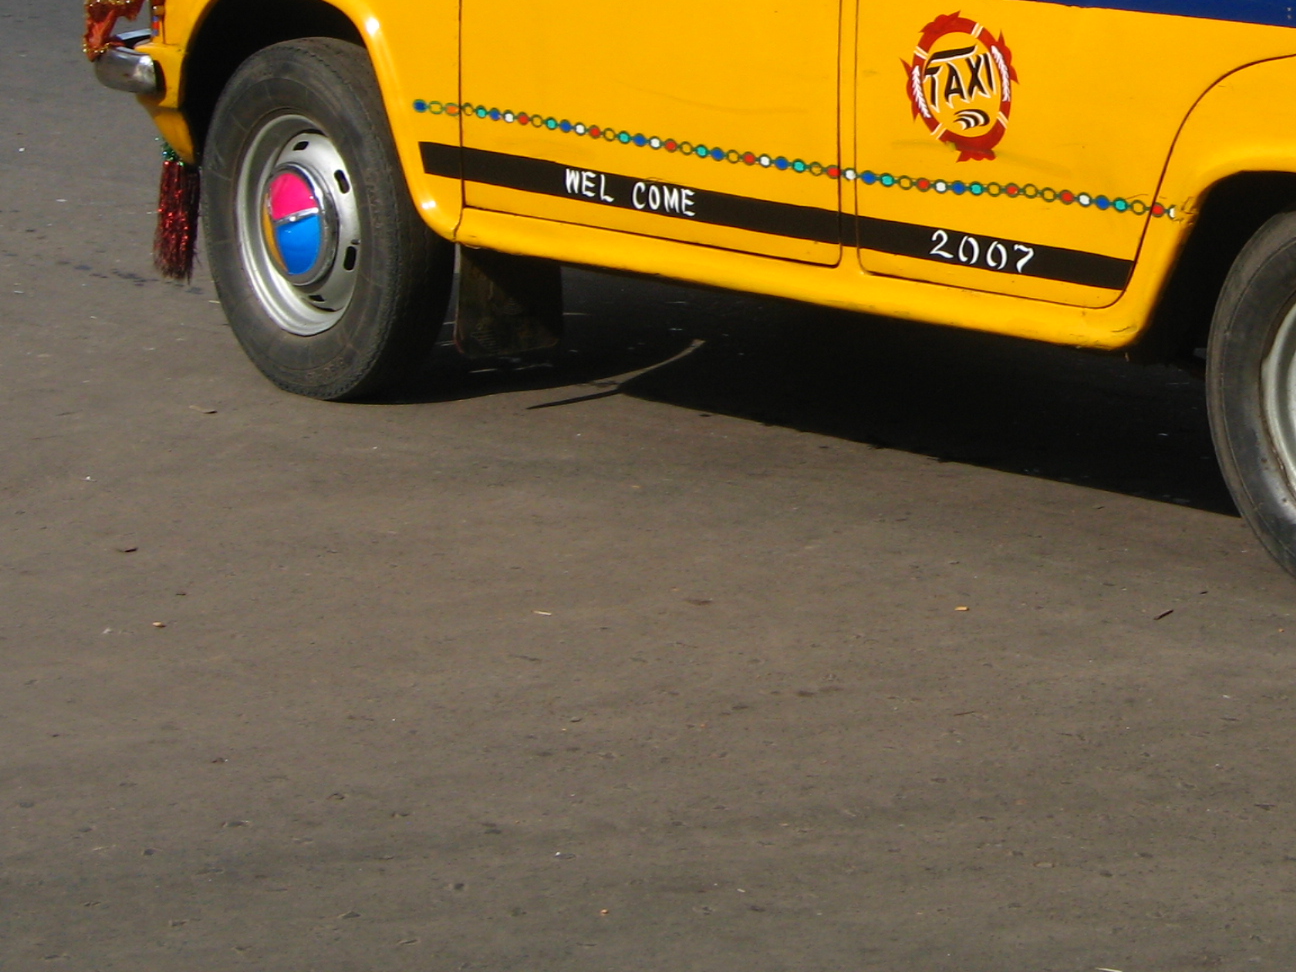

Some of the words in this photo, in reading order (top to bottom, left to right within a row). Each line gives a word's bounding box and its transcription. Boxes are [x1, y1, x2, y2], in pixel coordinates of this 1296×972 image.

[921, 43, 997, 113] TAXI
[565, 168, 614, 203] WEL
[632, 181, 696, 217] COME
[929, 229, 1035, 274] 2007
